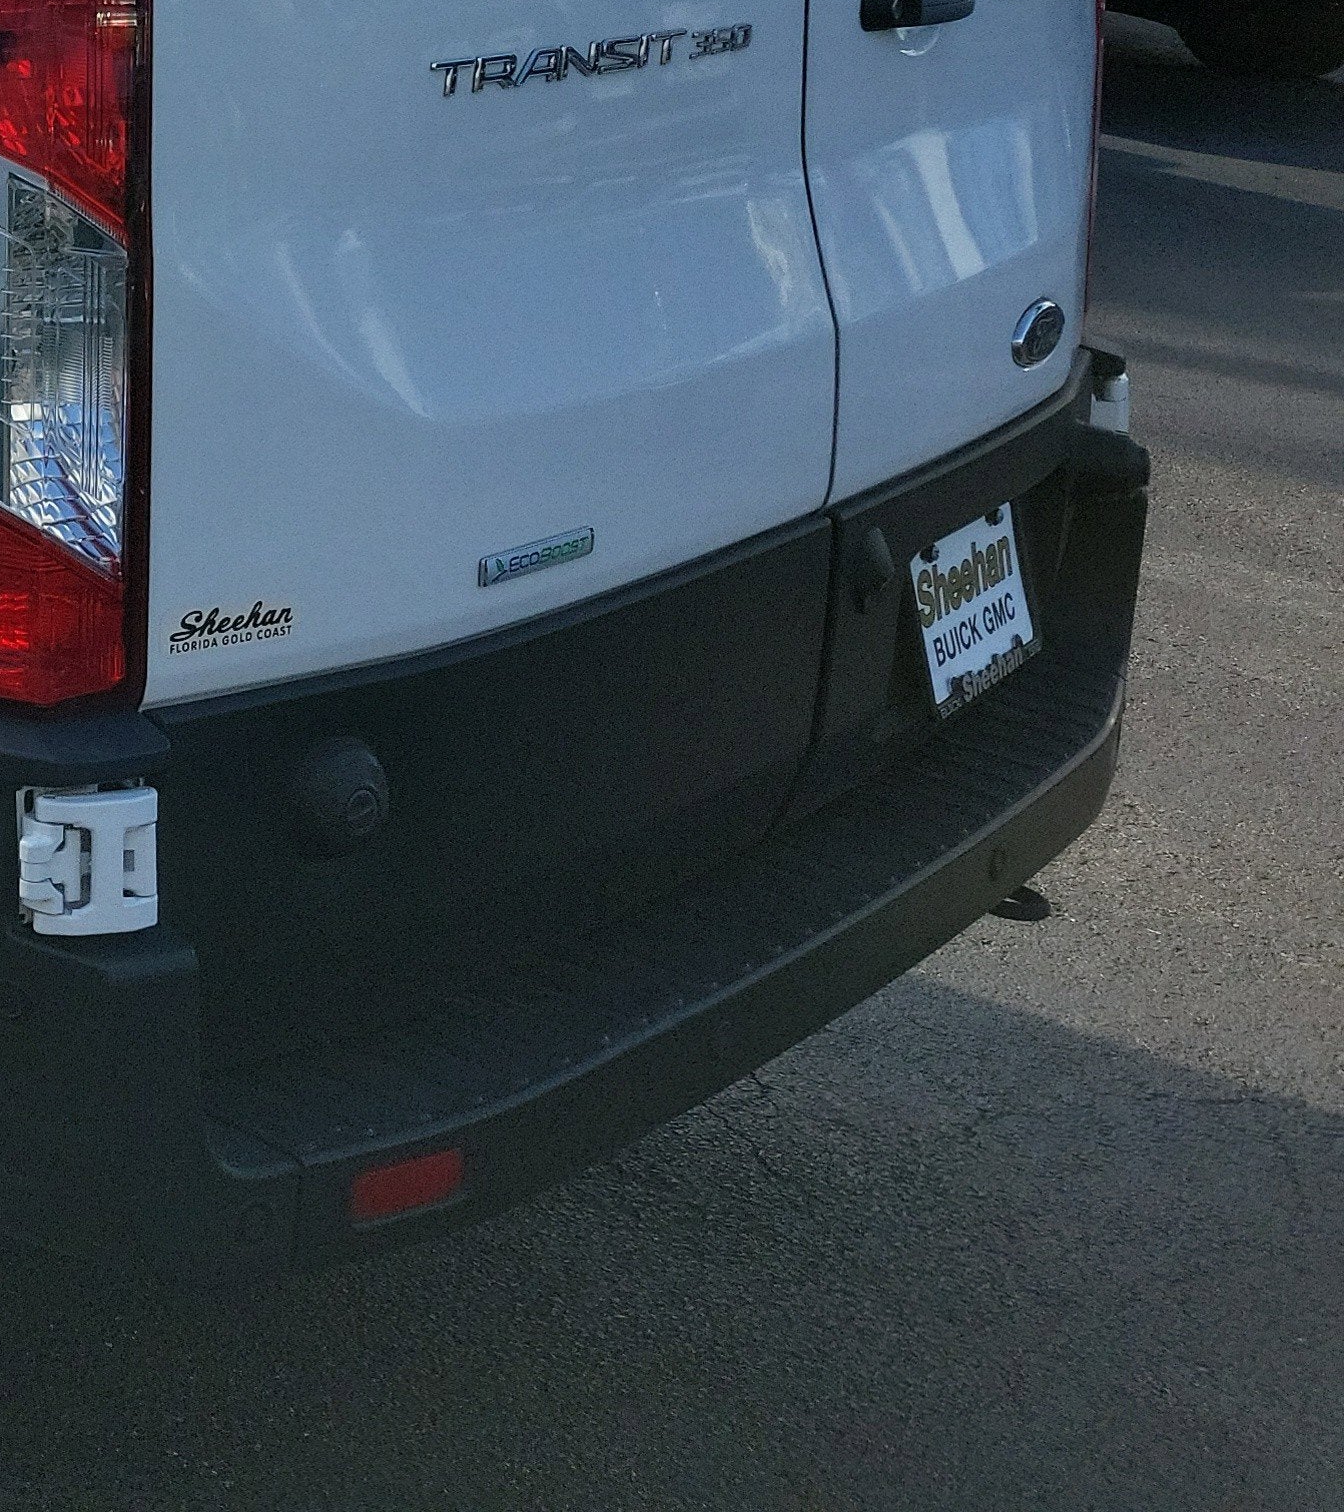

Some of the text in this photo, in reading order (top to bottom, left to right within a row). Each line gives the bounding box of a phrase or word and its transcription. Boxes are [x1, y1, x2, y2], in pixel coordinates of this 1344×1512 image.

[429, 24, 753, 97] TRANSIT 350
[915, 535, 1014, 629] Sheehan
[169, 600, 294, 642] Sheehan
[169, 624, 293, 655] FLORIDA GOLD COAST
[932, 613, 984, 668] BUICK
[982, 592, 1016, 635] GMC
[962, 647, 1024, 703] Sheehan
